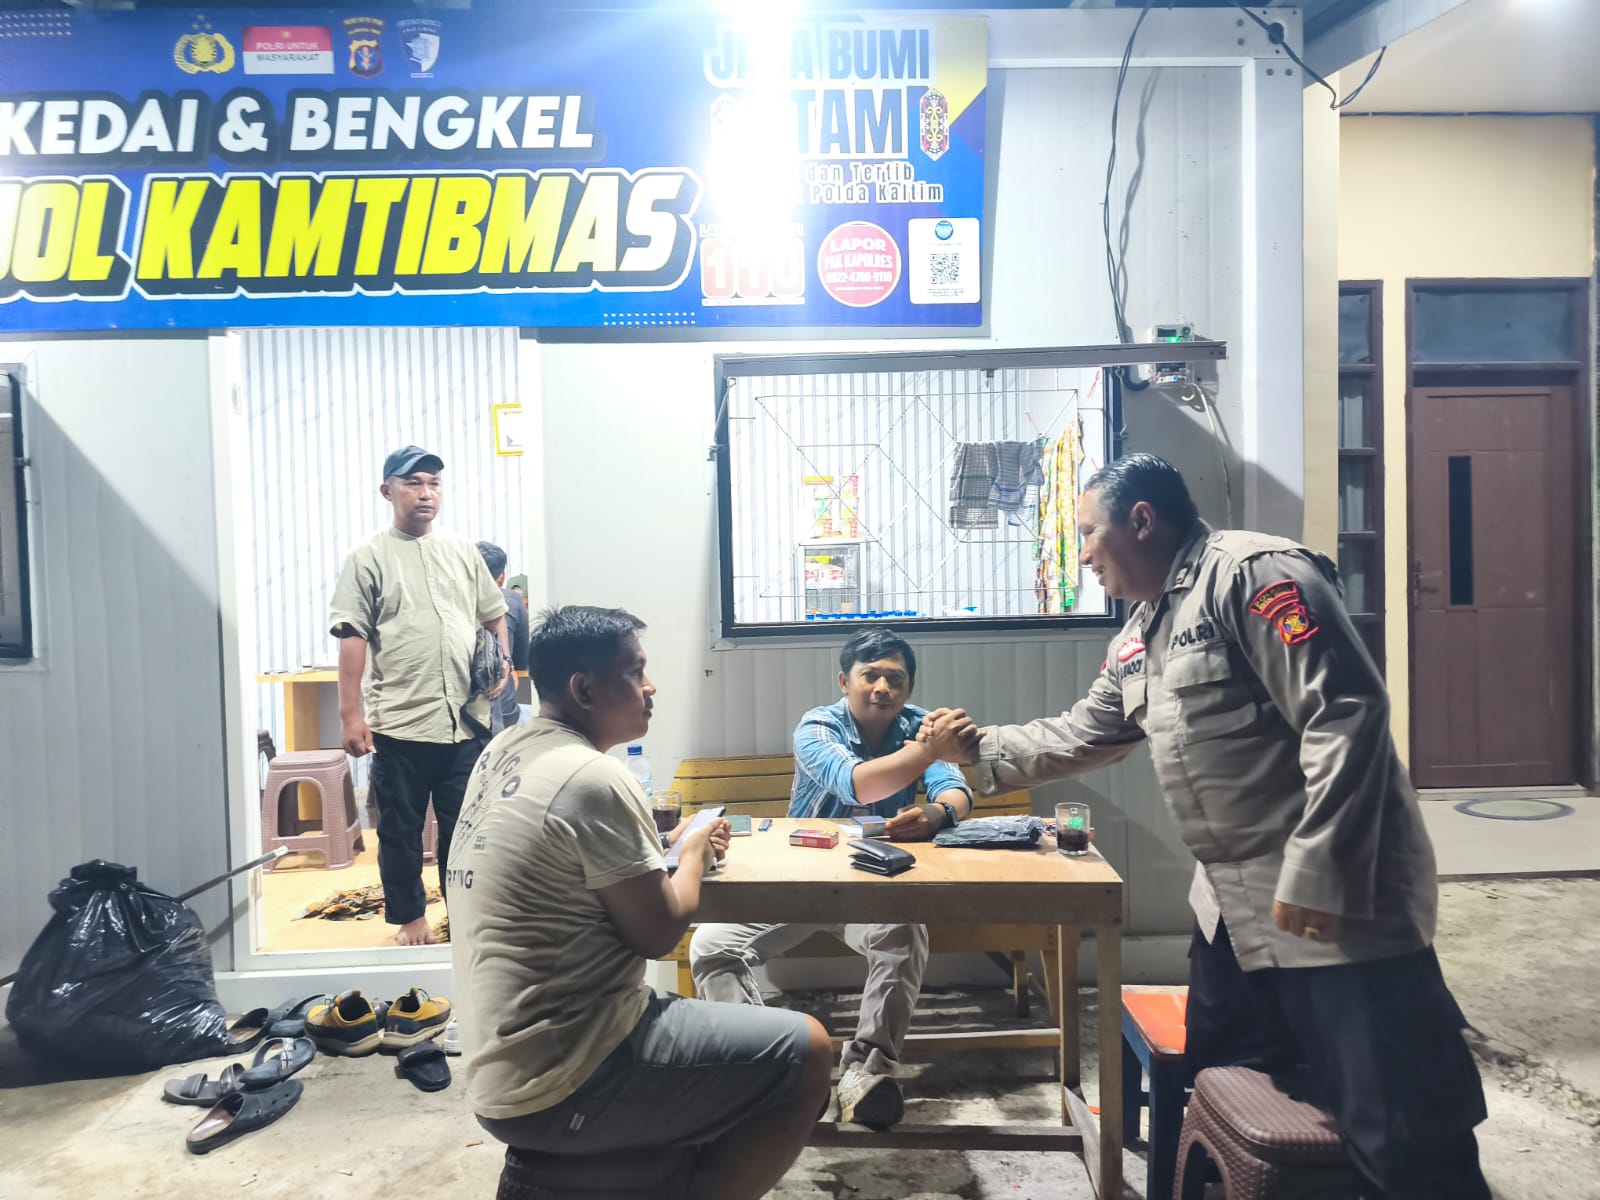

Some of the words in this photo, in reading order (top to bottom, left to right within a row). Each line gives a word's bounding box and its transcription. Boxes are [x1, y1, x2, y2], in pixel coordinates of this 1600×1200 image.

[255, 42, 285, 51] POLRI
[287, 42, 319, 51] UNTUK
[710, 29, 814, 80] JAA
[828, 29, 929, 80] BUMI
[0, 98, 199, 156] KEDAI
[217, 96, 269, 152] &
[289, 94, 594, 151] BENGKEL
[808, 162, 841, 182] dan
[853, 162, 913, 184] Tertib
[812, 183, 867, 201] Polda
[878, 182, 944, 201] Kaltim
[136, 174, 683, 280] KAMTIBMAS
[830, 237, 887, 252] LAPOR
